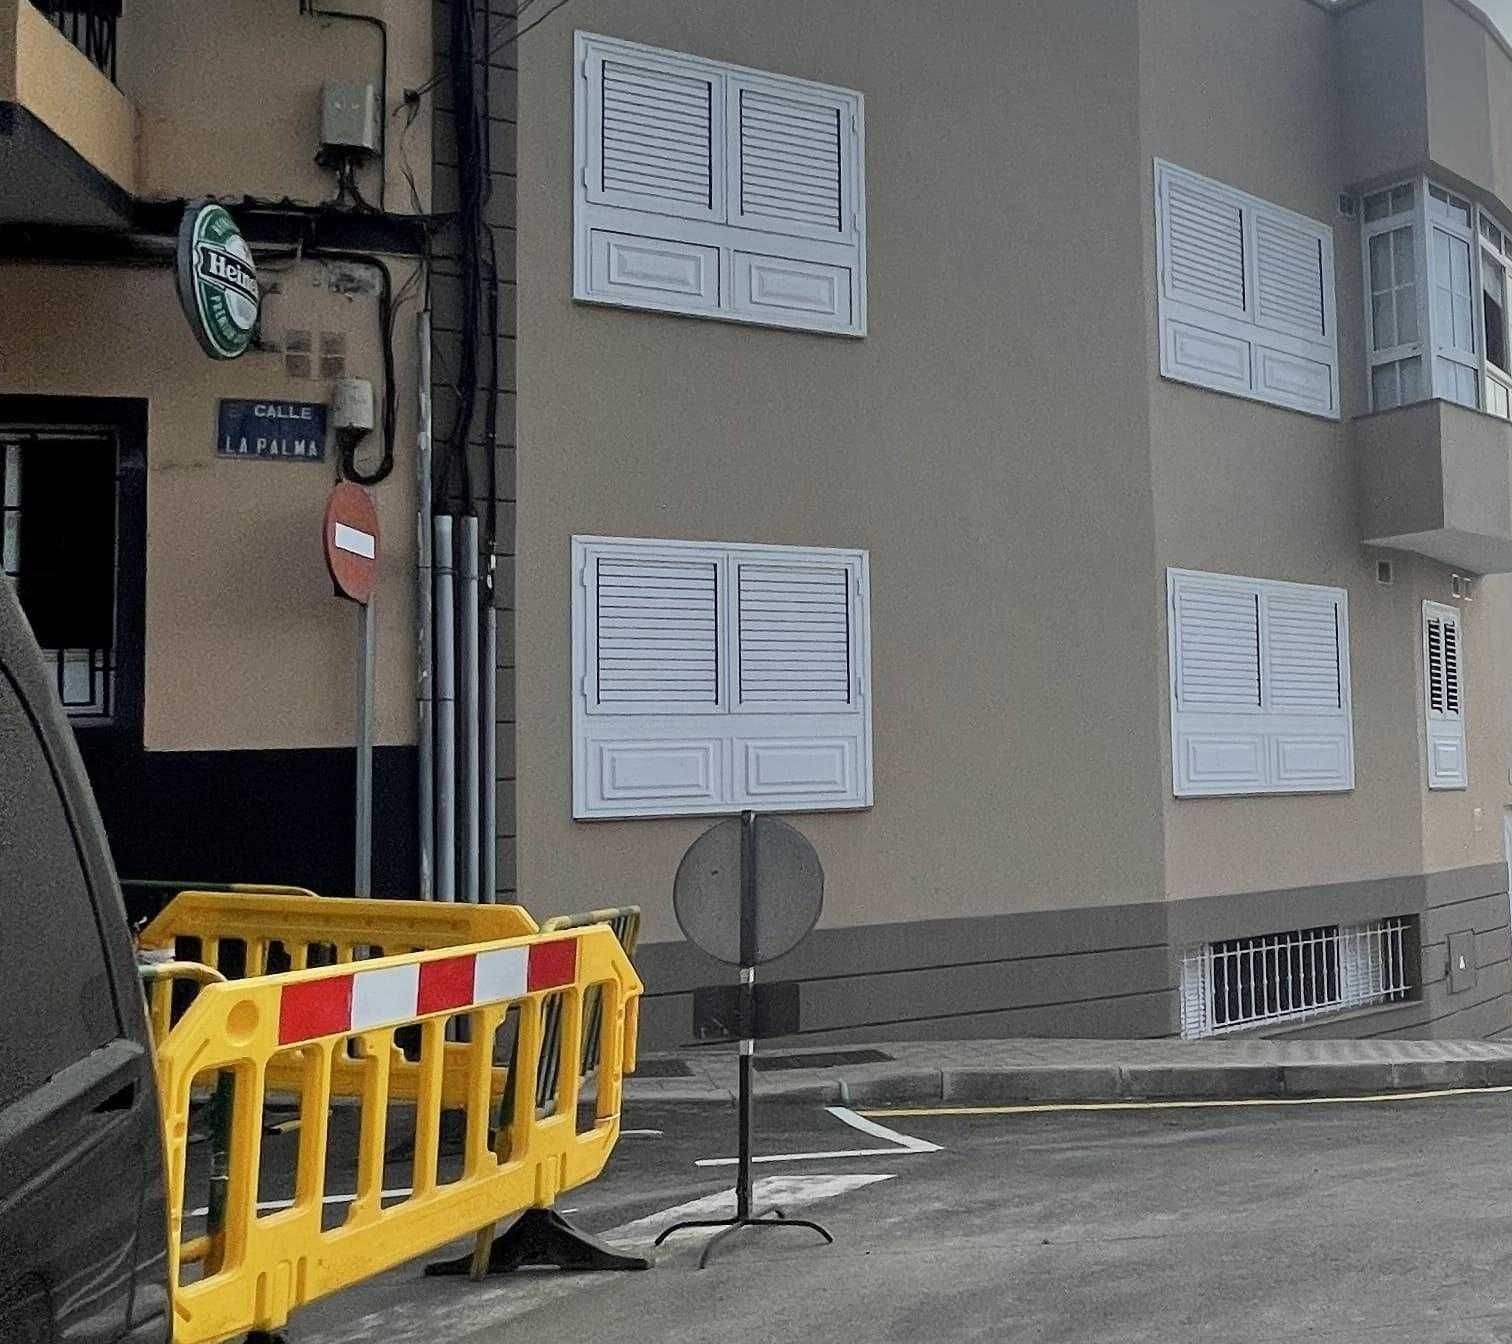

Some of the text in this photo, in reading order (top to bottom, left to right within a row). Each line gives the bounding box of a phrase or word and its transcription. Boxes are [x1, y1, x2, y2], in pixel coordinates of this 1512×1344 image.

[254, 404, 313, 420] CALLE
[225, 435, 318, 457] LA PALMA
